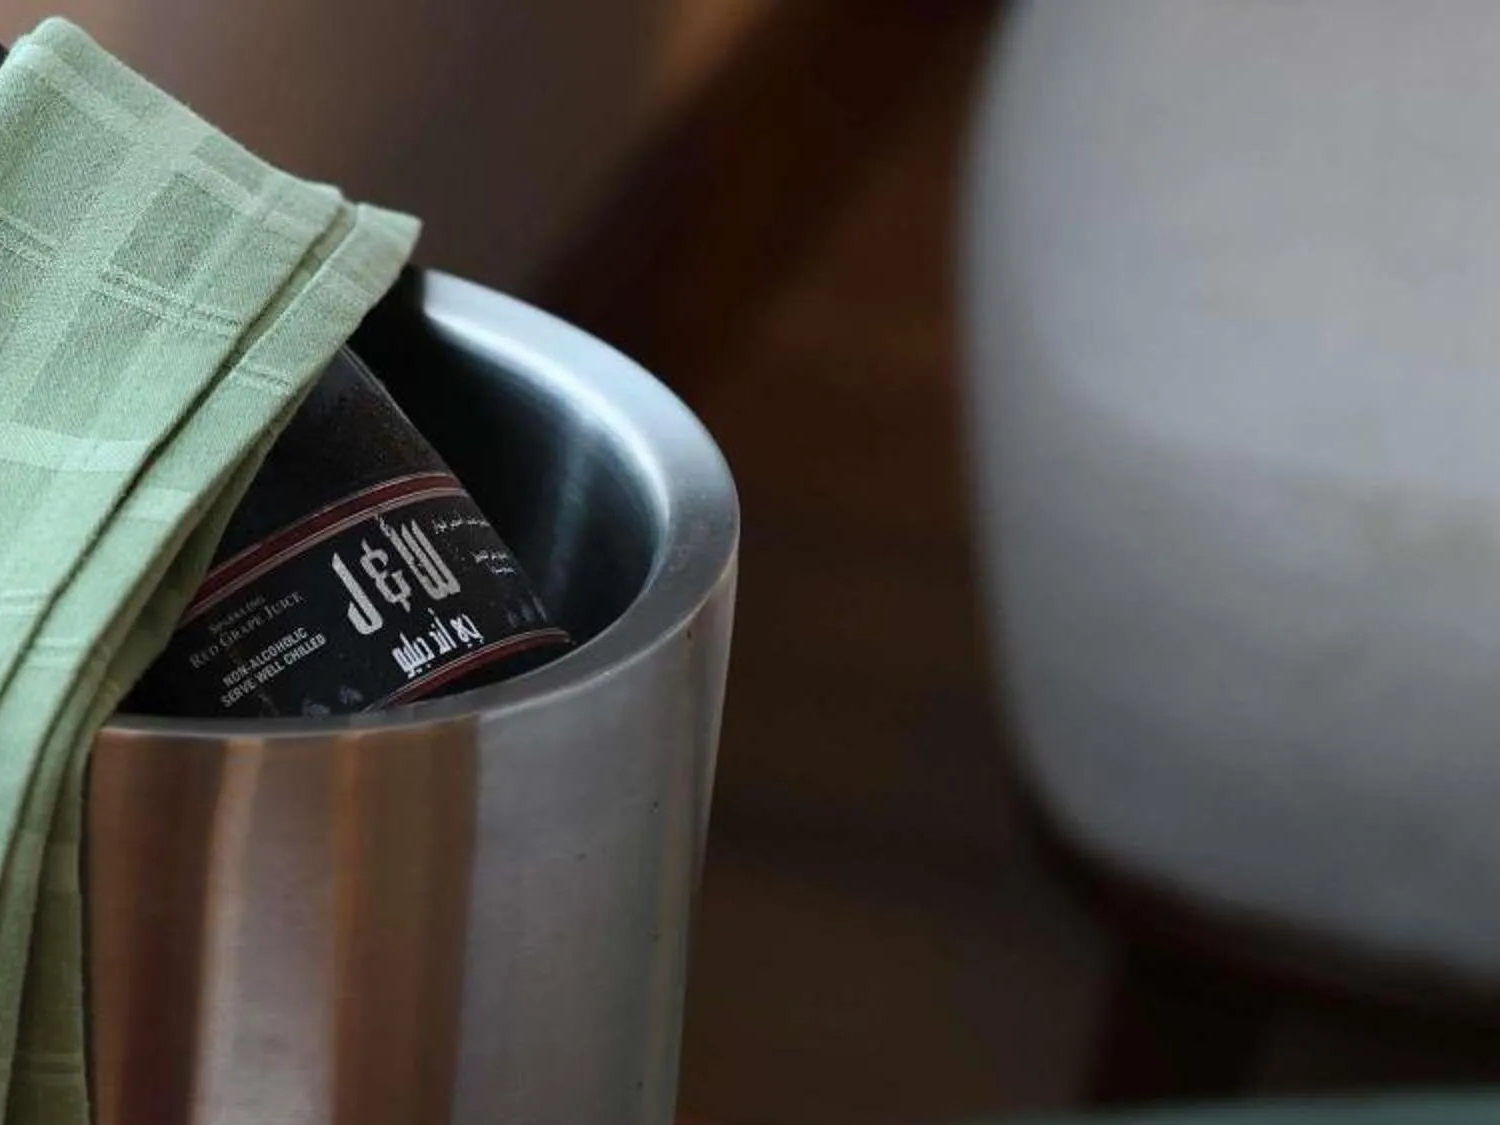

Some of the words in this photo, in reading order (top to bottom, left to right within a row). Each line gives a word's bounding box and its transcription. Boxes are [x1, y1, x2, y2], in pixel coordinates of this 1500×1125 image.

[220, 678, 257, 708] SERVE
[254, 661, 285, 683] WELL
[283, 633, 326, 665] CHILLED
[222, 627, 308, 687] NON-ALCOHOLIC
